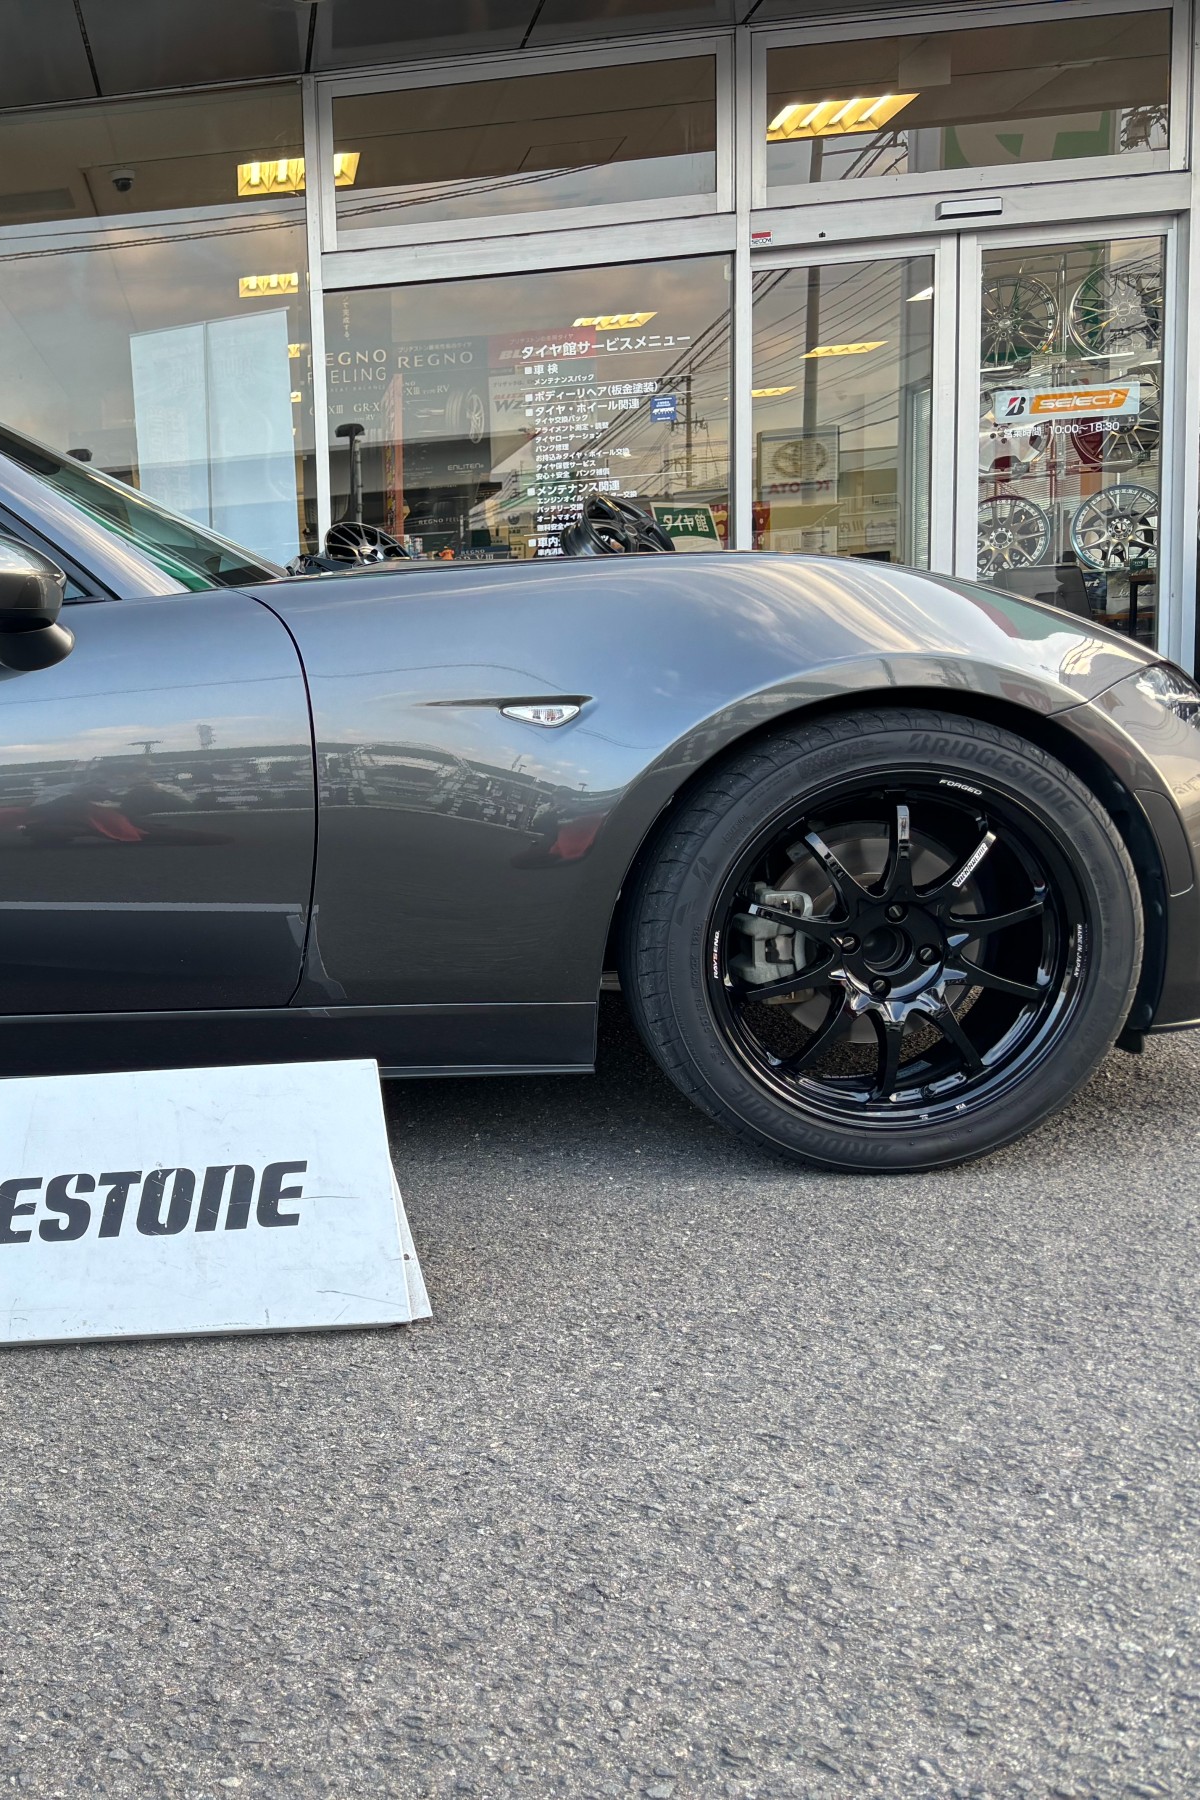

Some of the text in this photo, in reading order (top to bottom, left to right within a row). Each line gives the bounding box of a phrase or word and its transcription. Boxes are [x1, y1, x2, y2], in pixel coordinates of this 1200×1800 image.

[521, 335, 691, 359] タイヤ館サービスメニュー
[307, 350, 387, 367] EGNO
[398, 351, 473, 368] REGNO
[307, 367, 387, 385] FELING
[535, 398, 640, 417] タイヤ・ホイール関連
[536, 480, 621, 497] メンテナンス関連
[662, 513, 710, 532] タイヤ館
[909, 733, 1079, 818] BRIDGESTONE
[938, 778, 983, 796] FORGED
